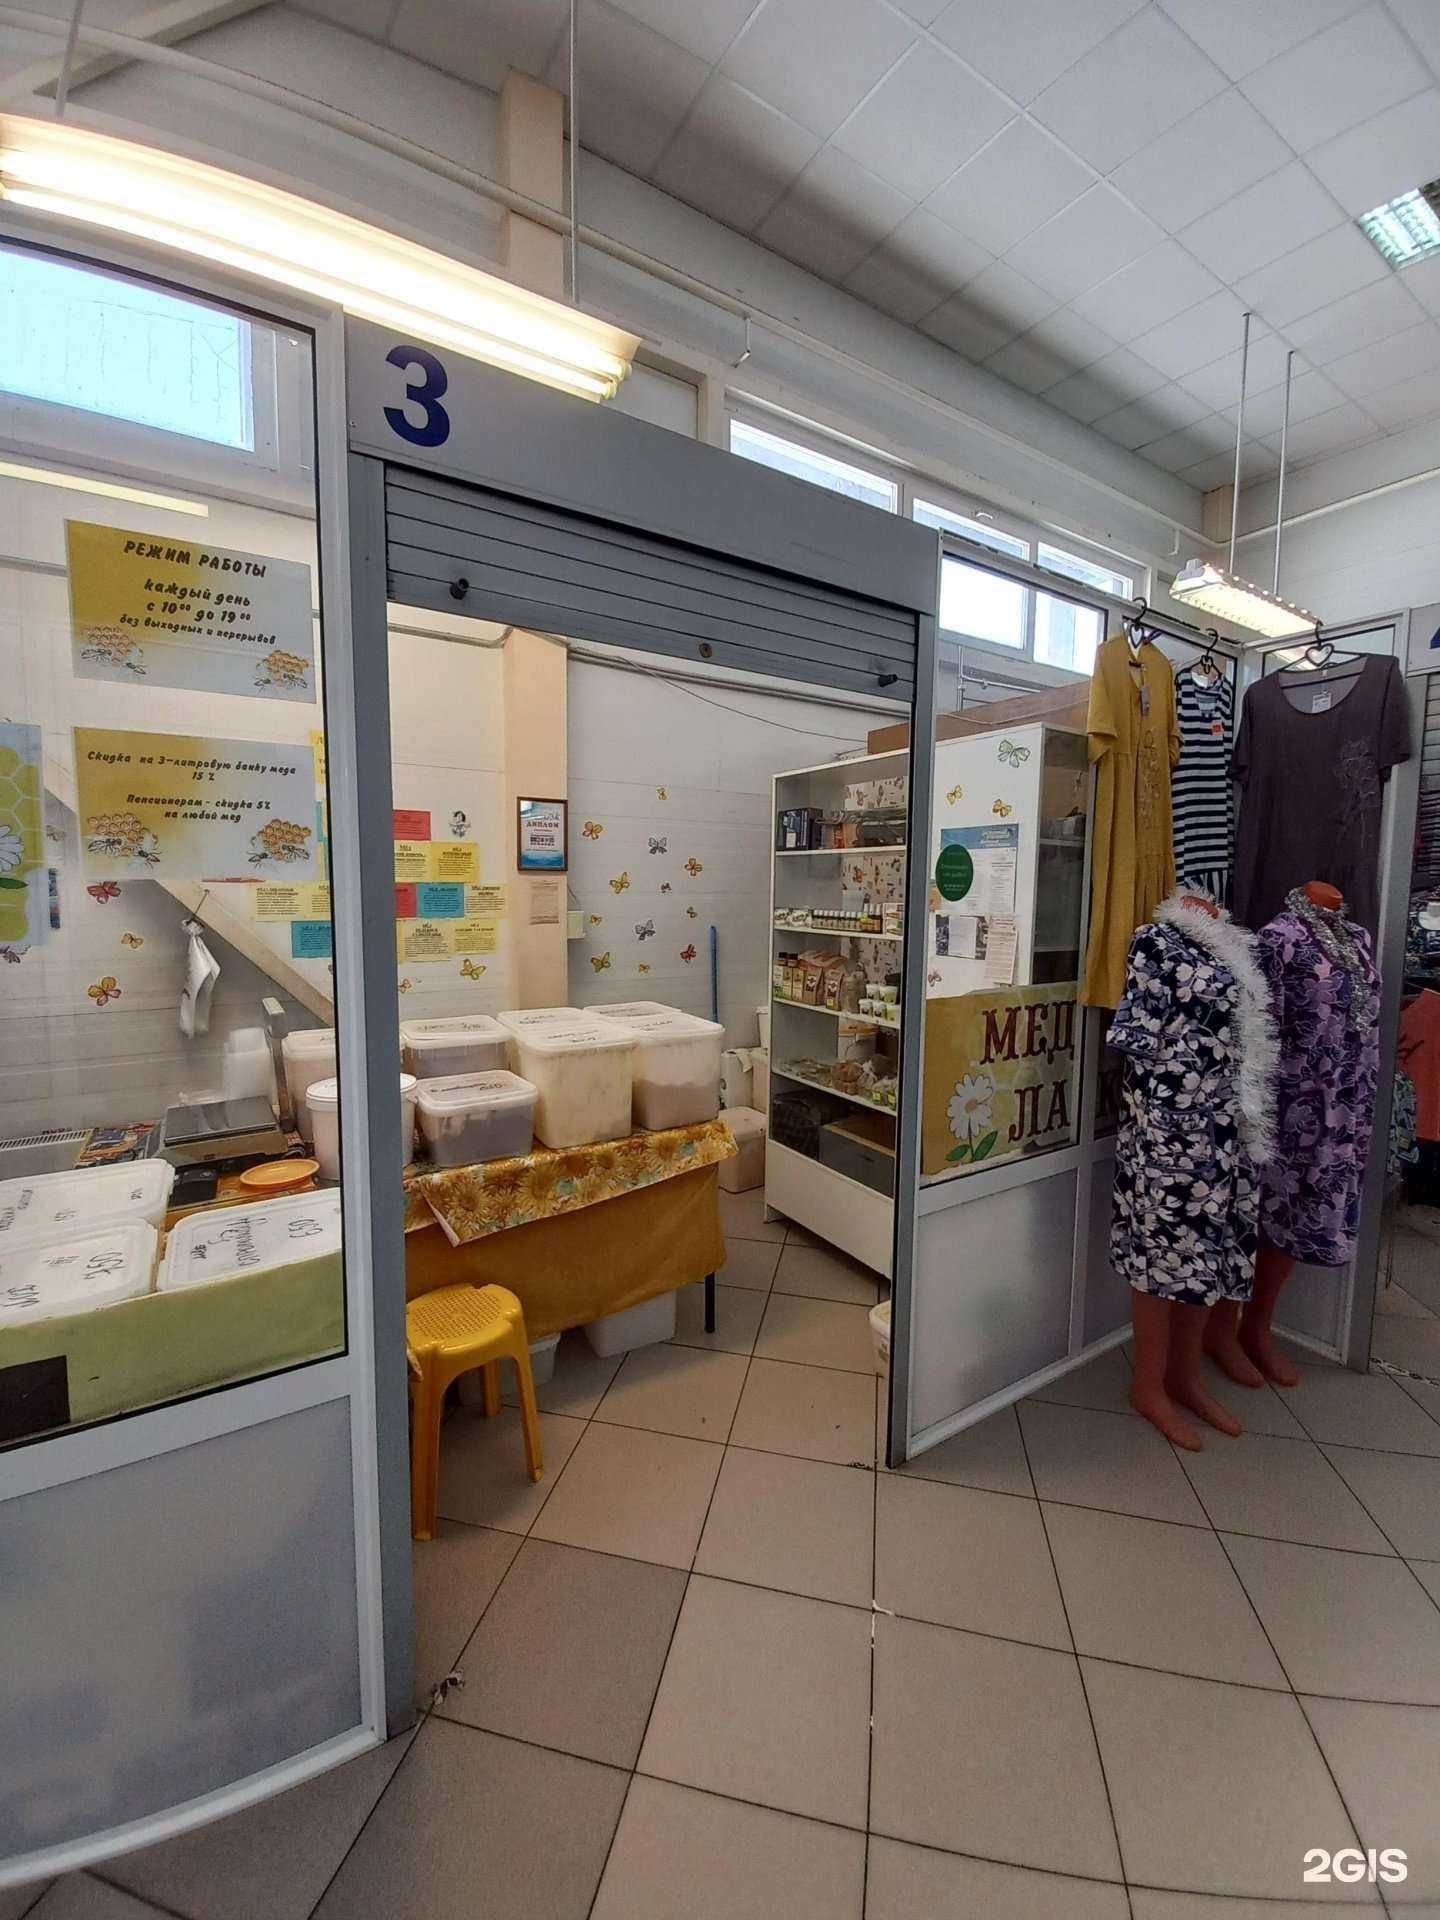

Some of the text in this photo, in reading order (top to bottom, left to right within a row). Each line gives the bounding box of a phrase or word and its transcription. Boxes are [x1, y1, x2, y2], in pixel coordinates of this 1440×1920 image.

[383, 345, 450, 447] 3
[123, 540, 266, 578] РЕЖИМ РАБОТЫ
[144, 579, 251, 606] каждый день
[146, 601, 155, 611] с
[194, 609, 215, 622] до
[119, 614, 139, 627] без
[144, 617, 203, 633] выходных
[216, 629, 276, 645] перерывов
[87, 751, 296, 776] Скидка на 3-литровую банку меда
[126, 794, 202, 807] Пенсионерам
[215, 799, 253, 810] скидка
[164, 810, 241, 823] на любой мед
